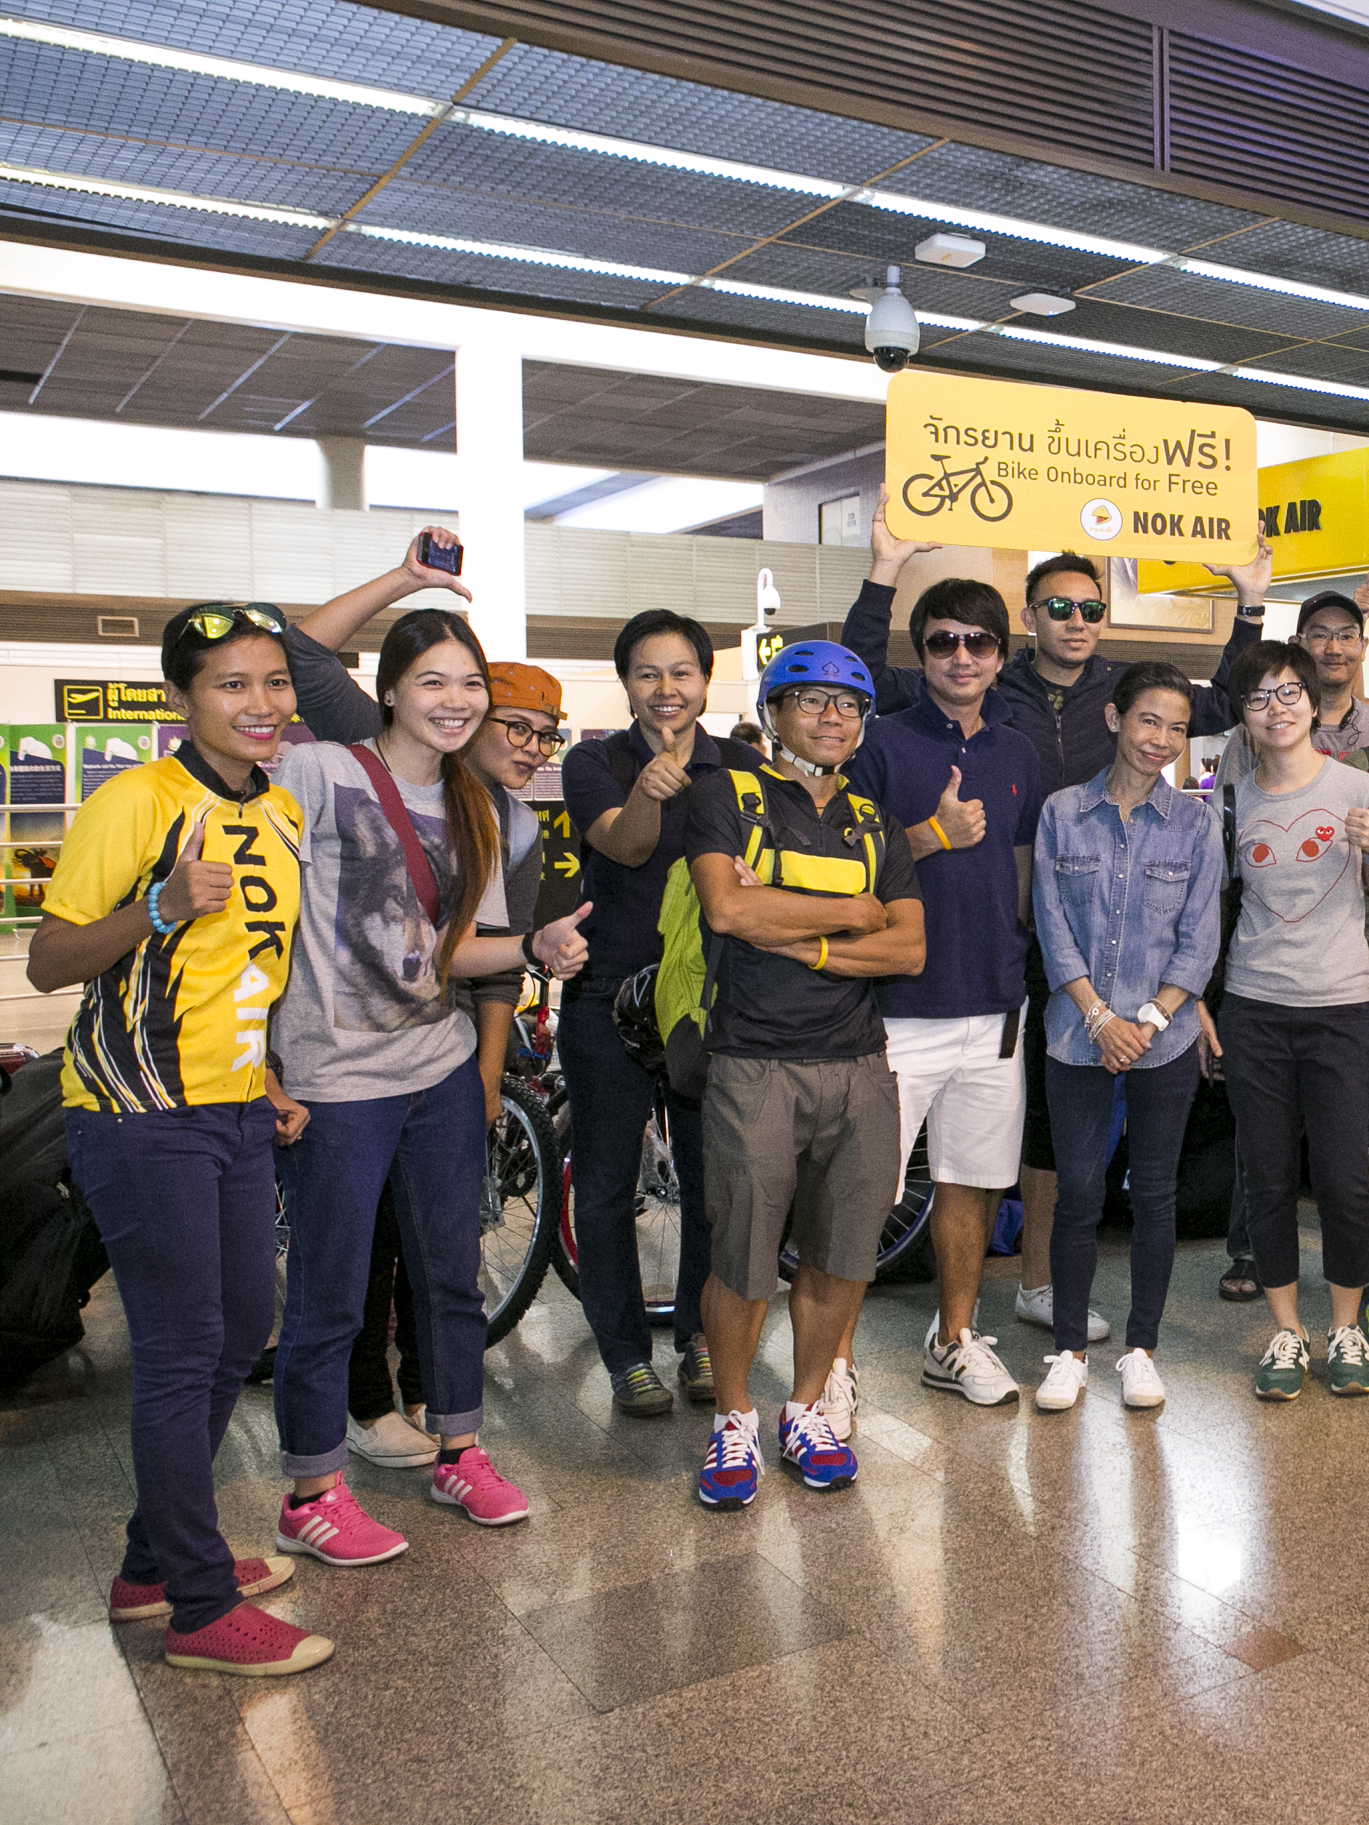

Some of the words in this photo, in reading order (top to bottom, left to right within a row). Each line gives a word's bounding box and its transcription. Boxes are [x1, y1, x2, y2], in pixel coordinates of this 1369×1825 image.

[923, 415, 1034, 454] จักรยาน
[997, 461, 1039, 482] Bike
[1046, 467, 1128, 490] Onboard
[1134, 472, 1161, 492] for
[1168, 474, 1219, 497] Free
[1133, 511, 1185, 538] NOK
[1191, 516, 1232, 541] AIR
[1284, 499, 1322, 534] AIR
[221, 824, 287, 961] NOK
[231, 961, 269, 1073] AIR
